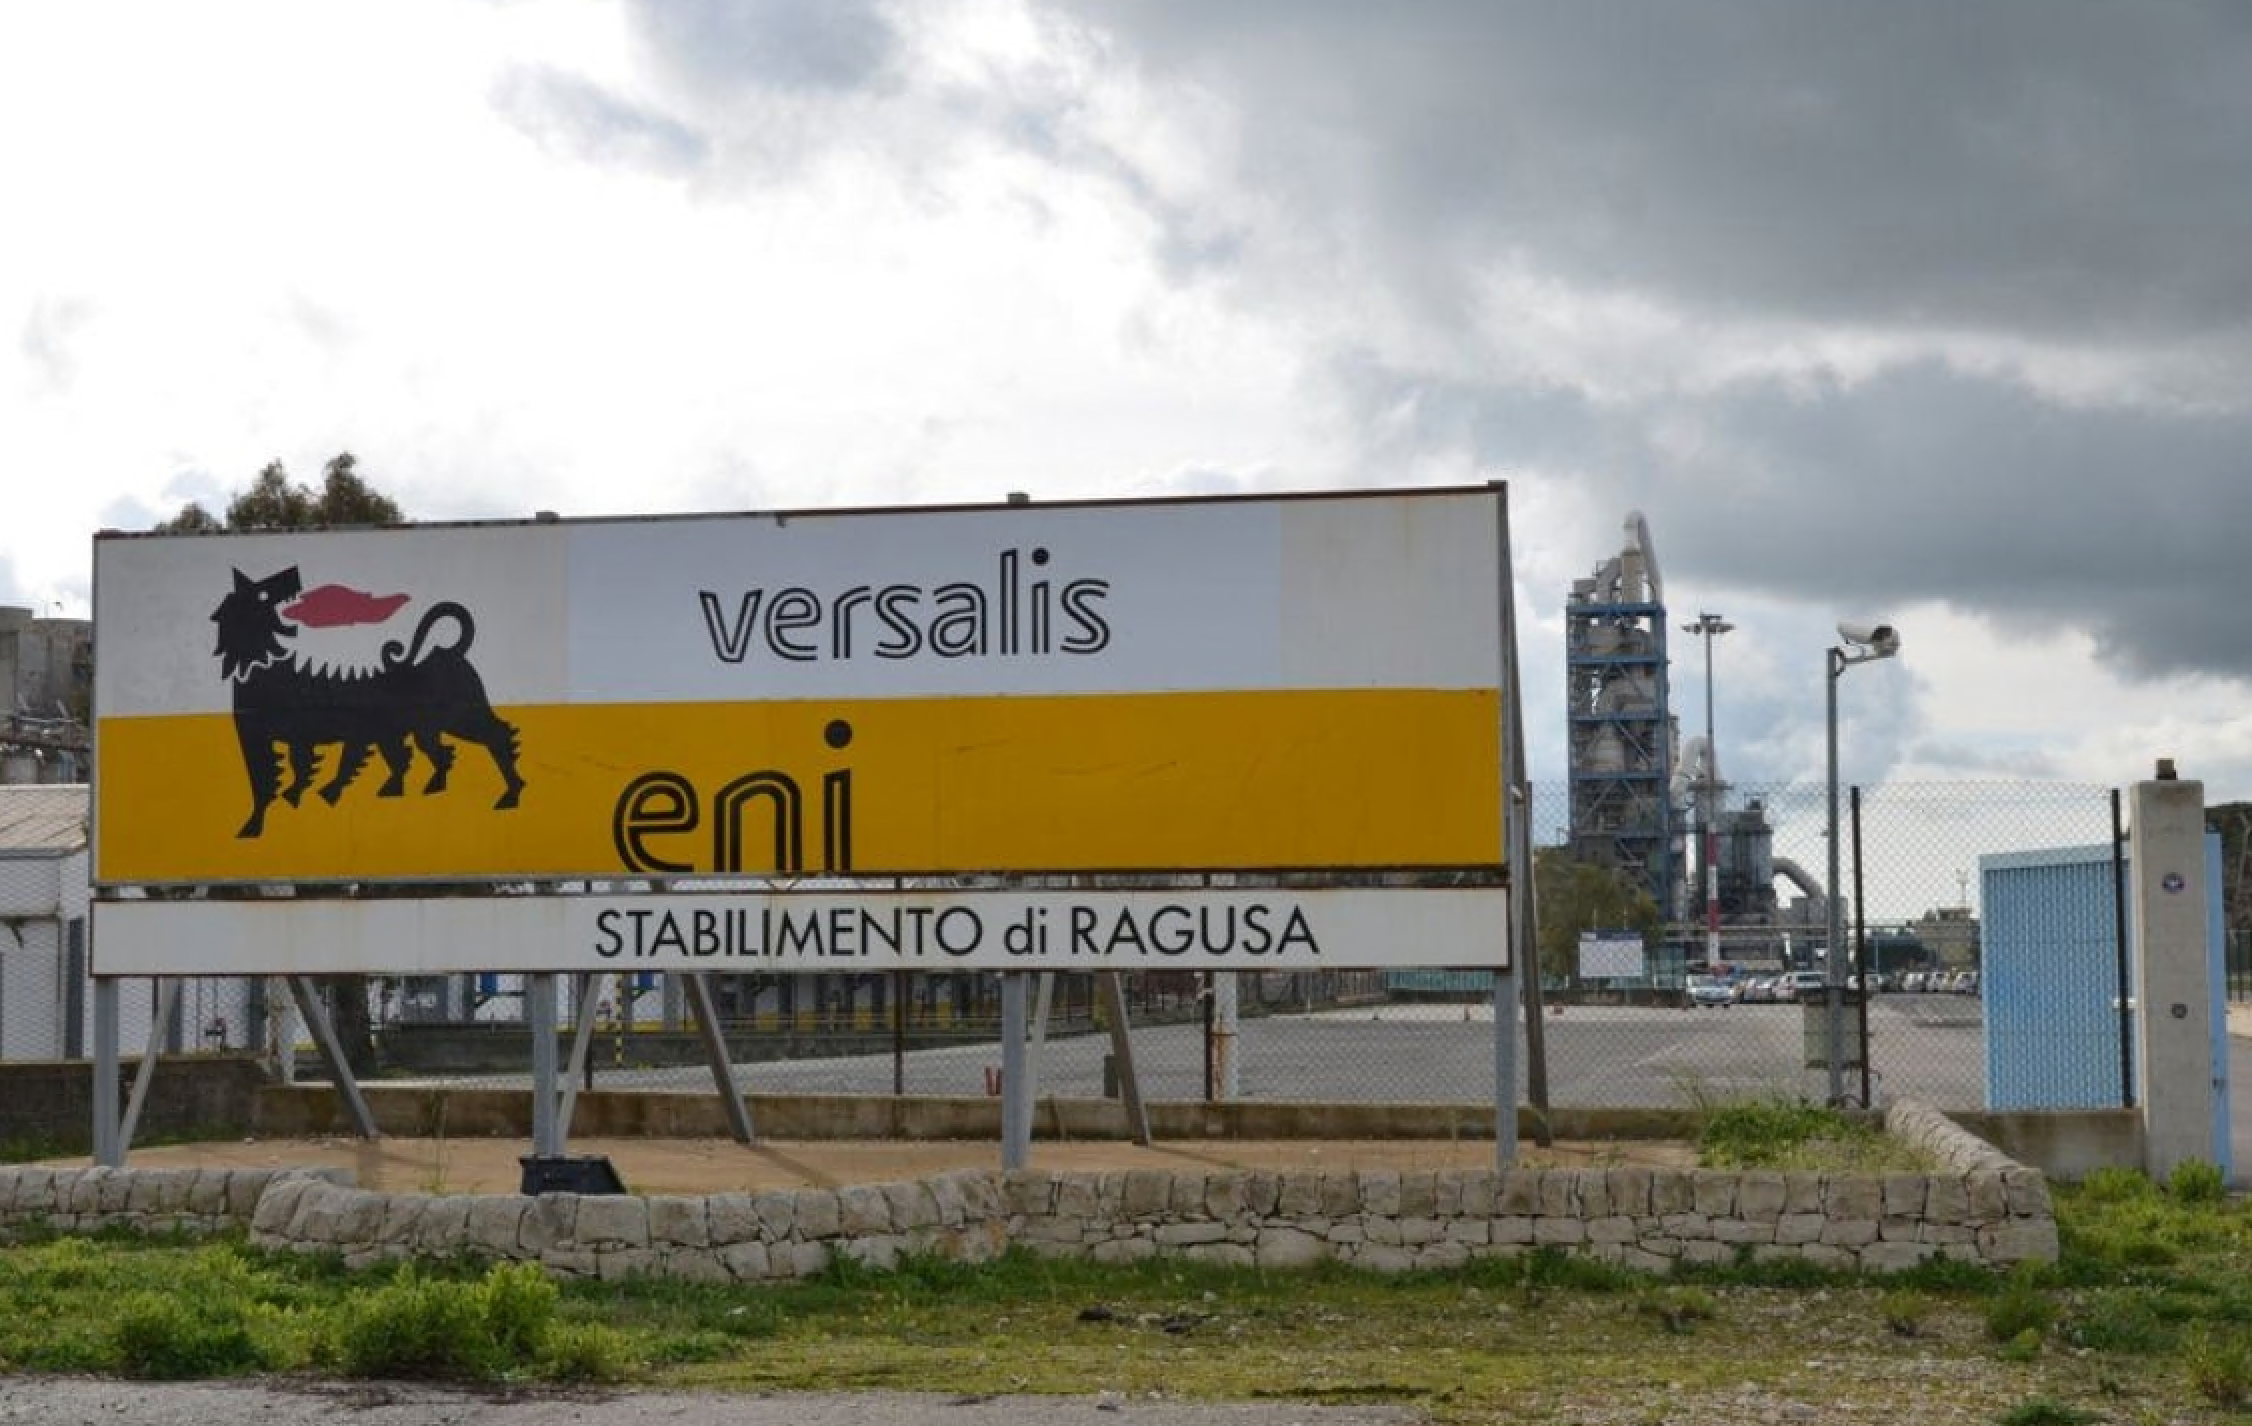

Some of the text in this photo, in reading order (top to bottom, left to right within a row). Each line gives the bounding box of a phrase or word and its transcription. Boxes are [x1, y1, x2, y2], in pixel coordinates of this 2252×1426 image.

[698, 548, 1110, 663] versalis
[613, 719, 852, 873] eni
[595, 904, 1319, 959] STABILIMENTO di RAGUSA
